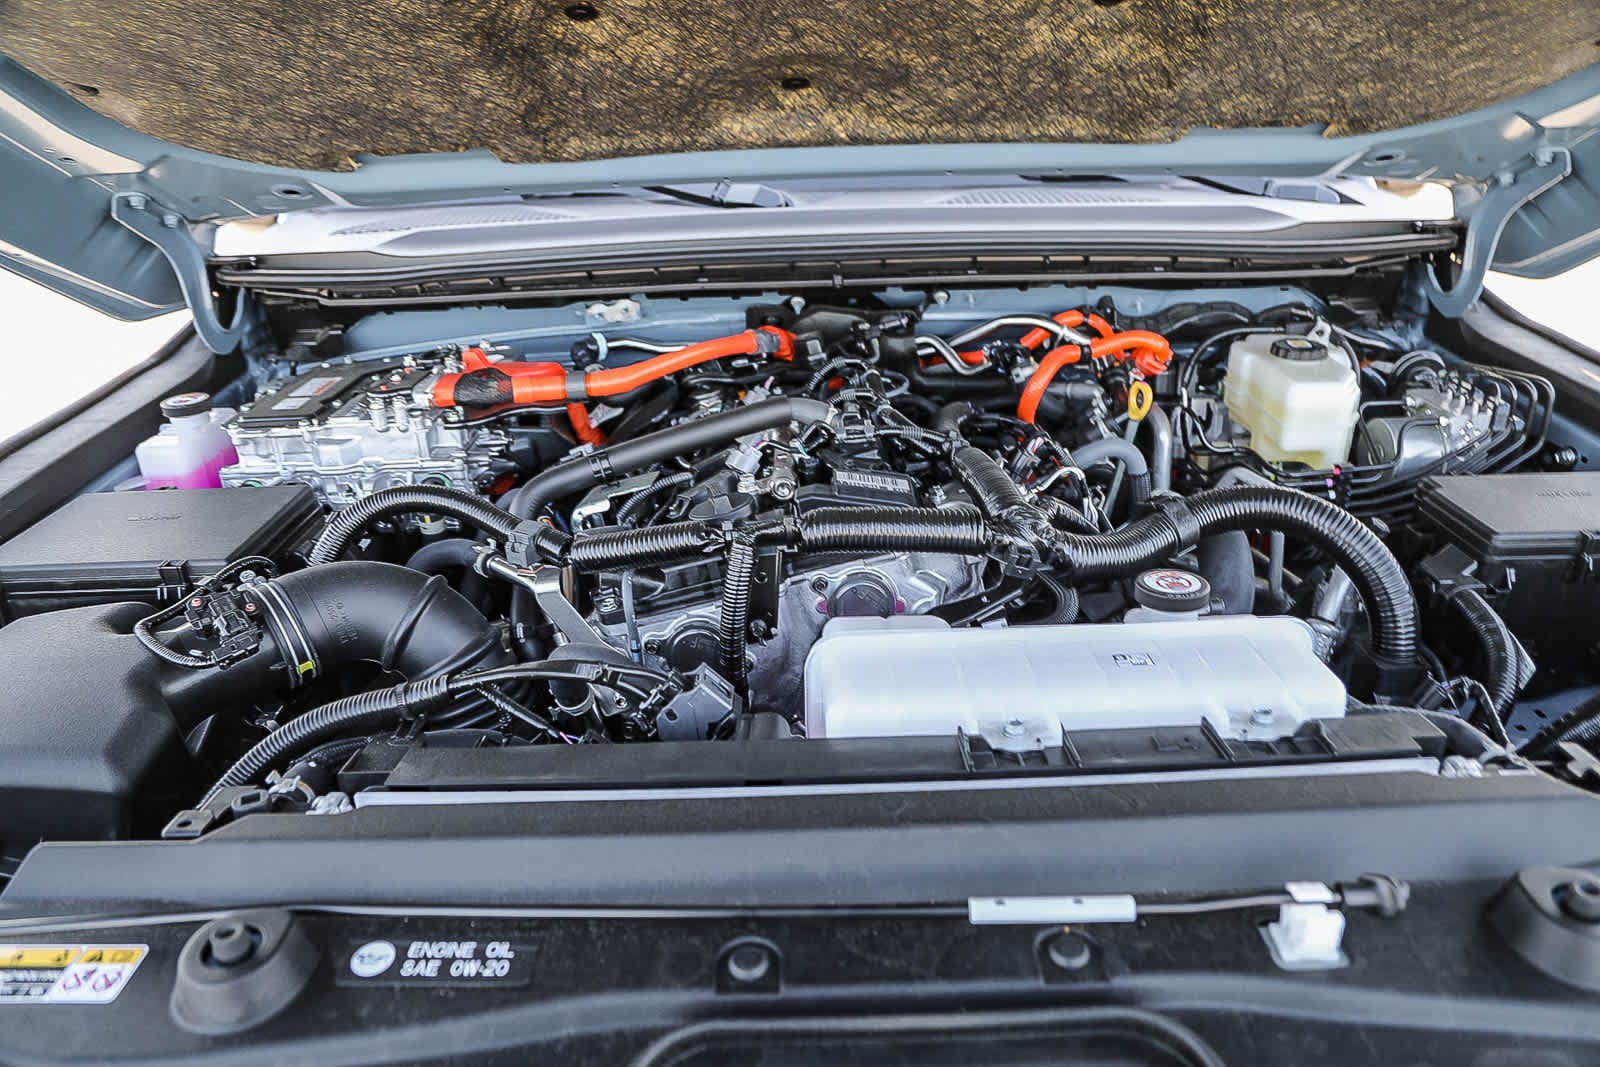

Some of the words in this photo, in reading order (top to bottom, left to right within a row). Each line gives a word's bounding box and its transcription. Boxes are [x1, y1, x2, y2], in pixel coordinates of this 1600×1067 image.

[407, 941, 477, 959] ENGINE
[485, 941, 515, 959] OIL
[400, 959, 442, 977] SAE
[450, 959, 510, 977] 0W-20
